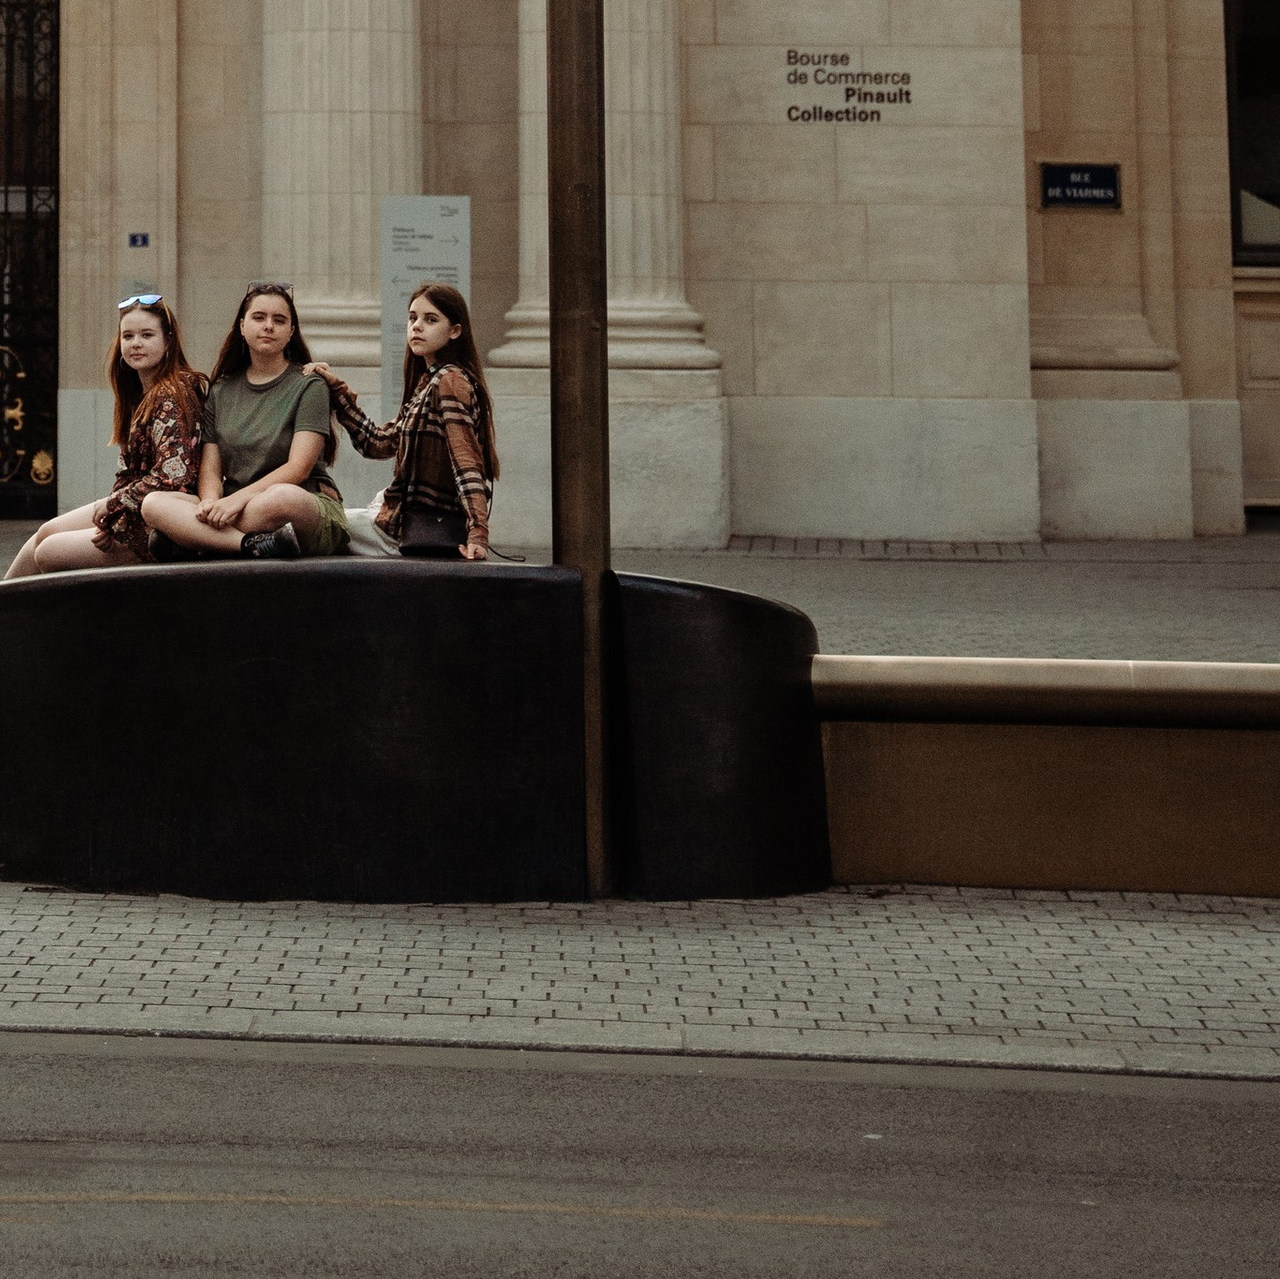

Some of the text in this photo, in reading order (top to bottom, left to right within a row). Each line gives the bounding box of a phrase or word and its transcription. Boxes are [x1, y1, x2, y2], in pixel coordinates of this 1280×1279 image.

[787, 49, 851, 66] Bourse
[786, 69, 912, 85] de Commerce
[845, 88, 912, 104] Pinault
[787, 106, 882, 123] Collection
